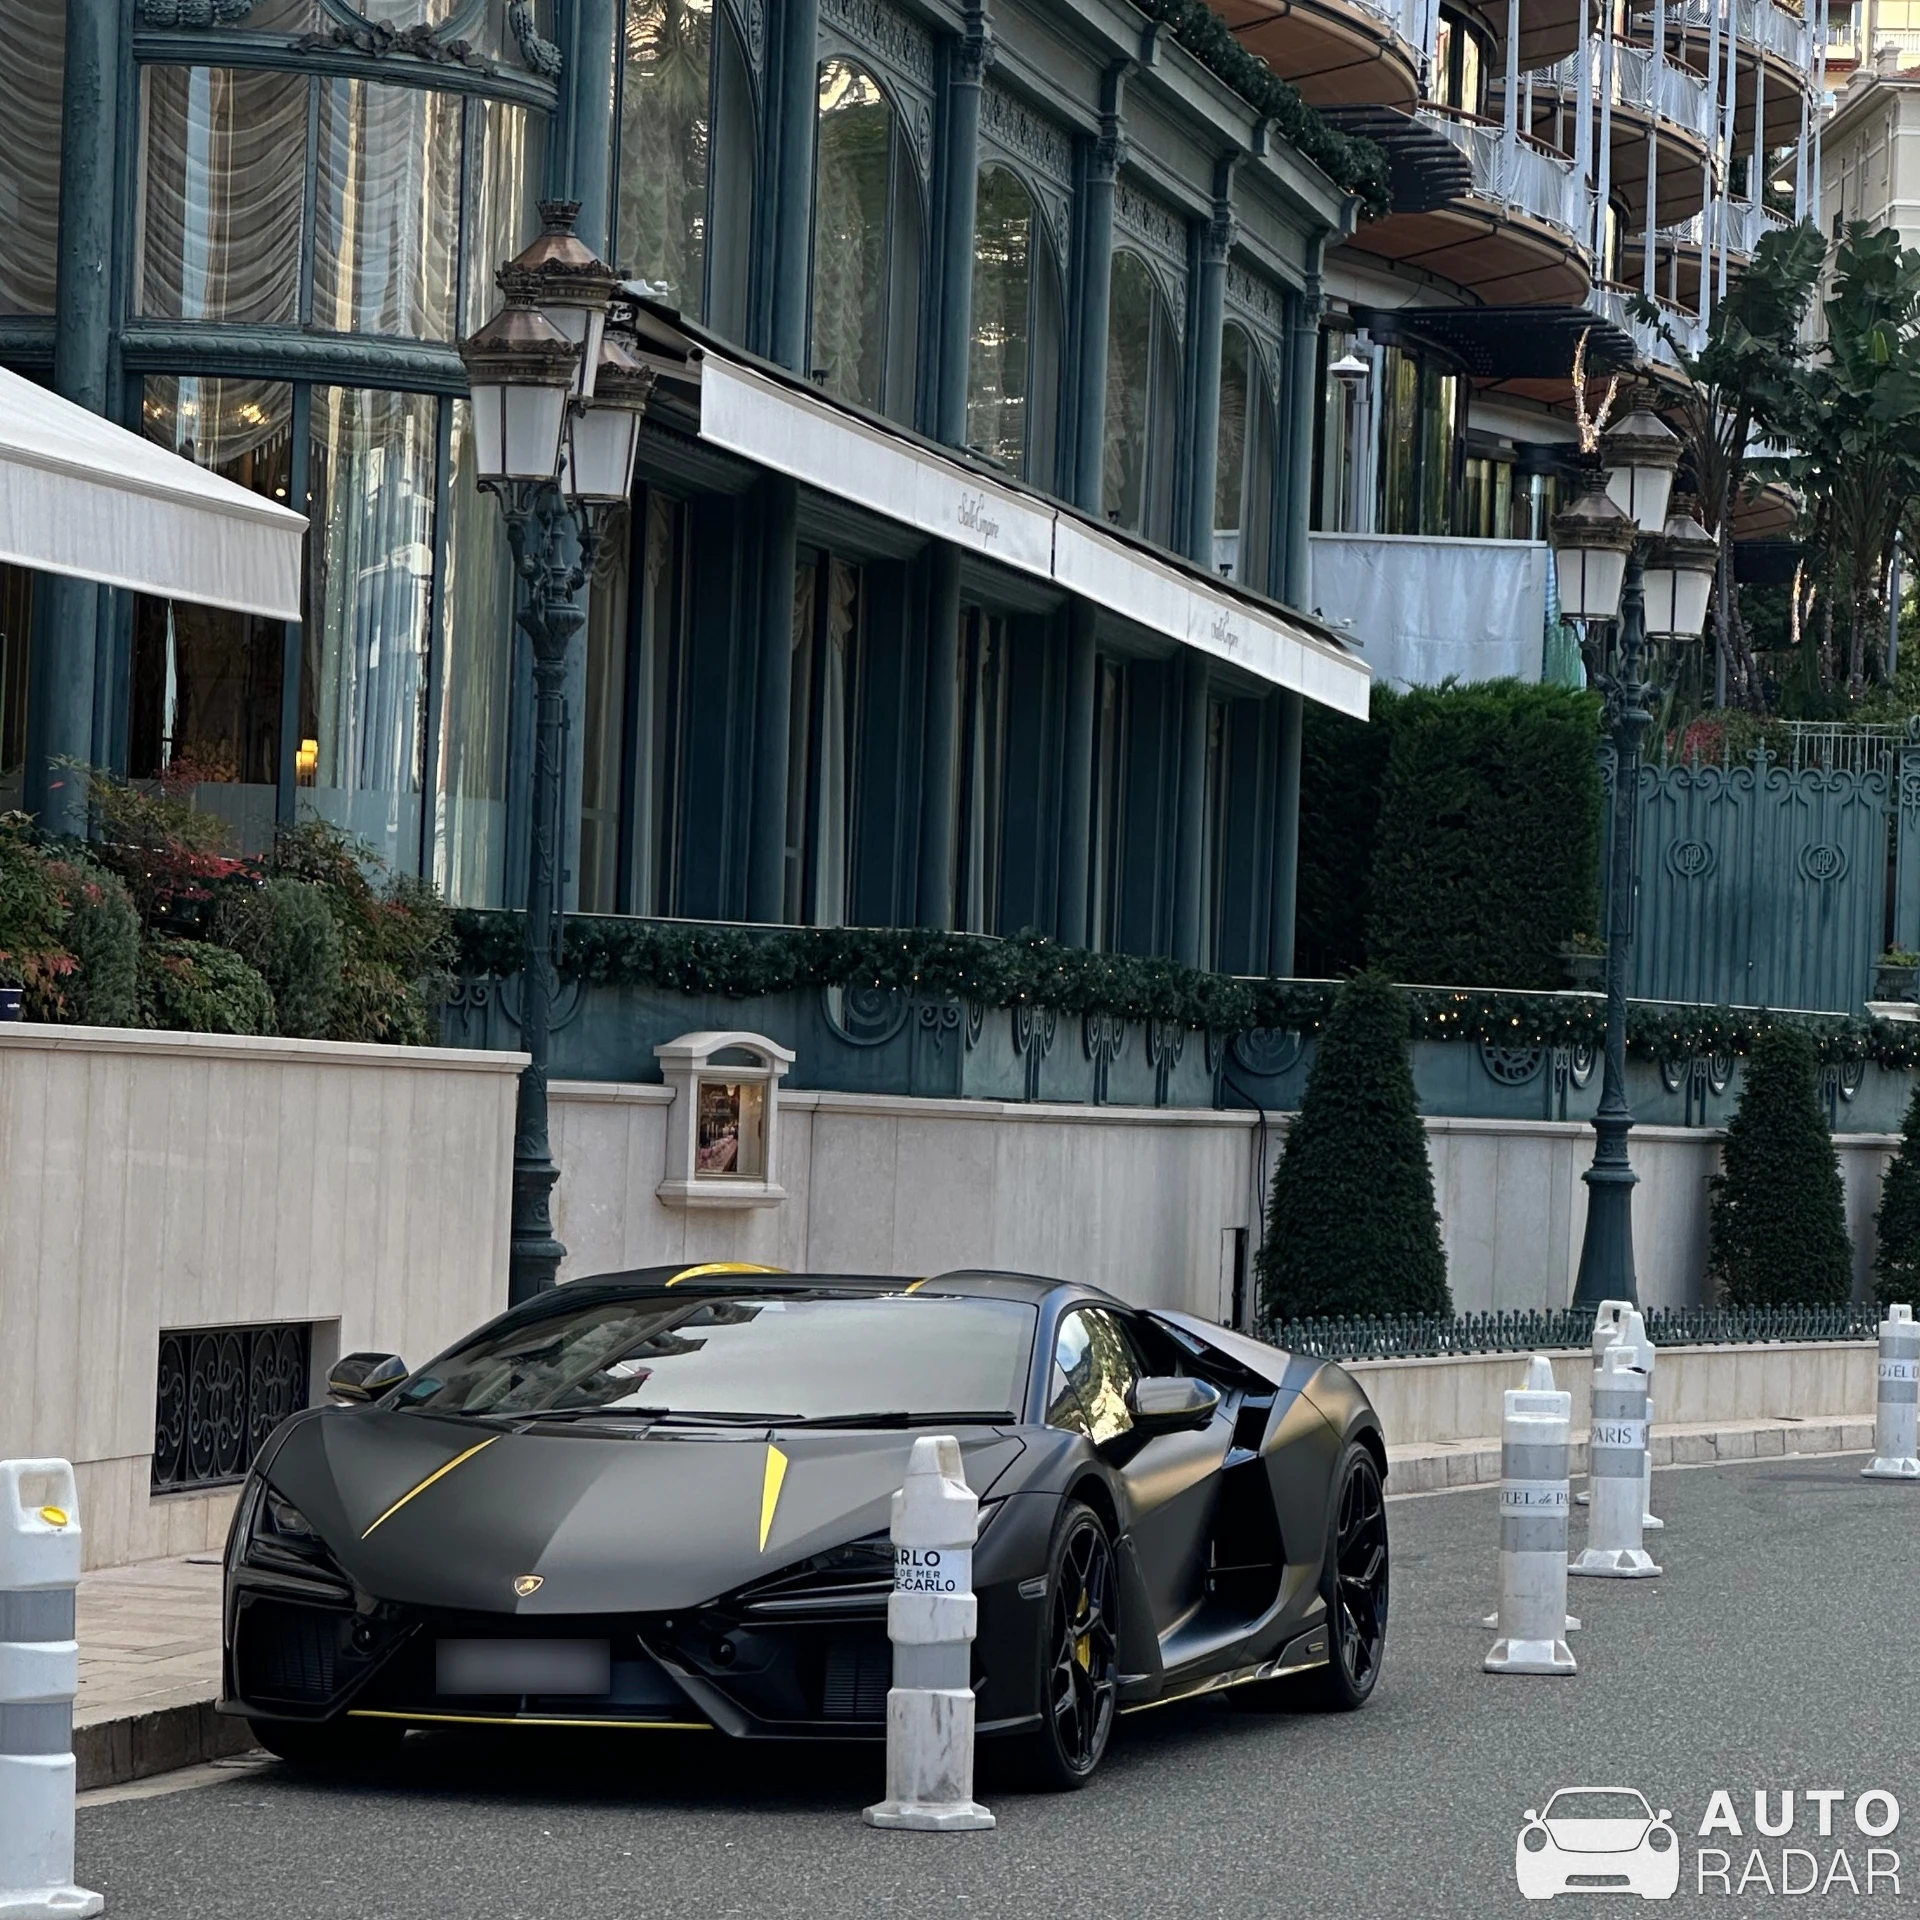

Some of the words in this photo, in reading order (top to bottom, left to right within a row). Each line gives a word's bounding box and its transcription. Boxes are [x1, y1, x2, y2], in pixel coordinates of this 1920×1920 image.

[1538, 1493, 1552, 1505] de
[900, 1568, 913, 1578] DE
[916, 1569, 941, 1579] MER
